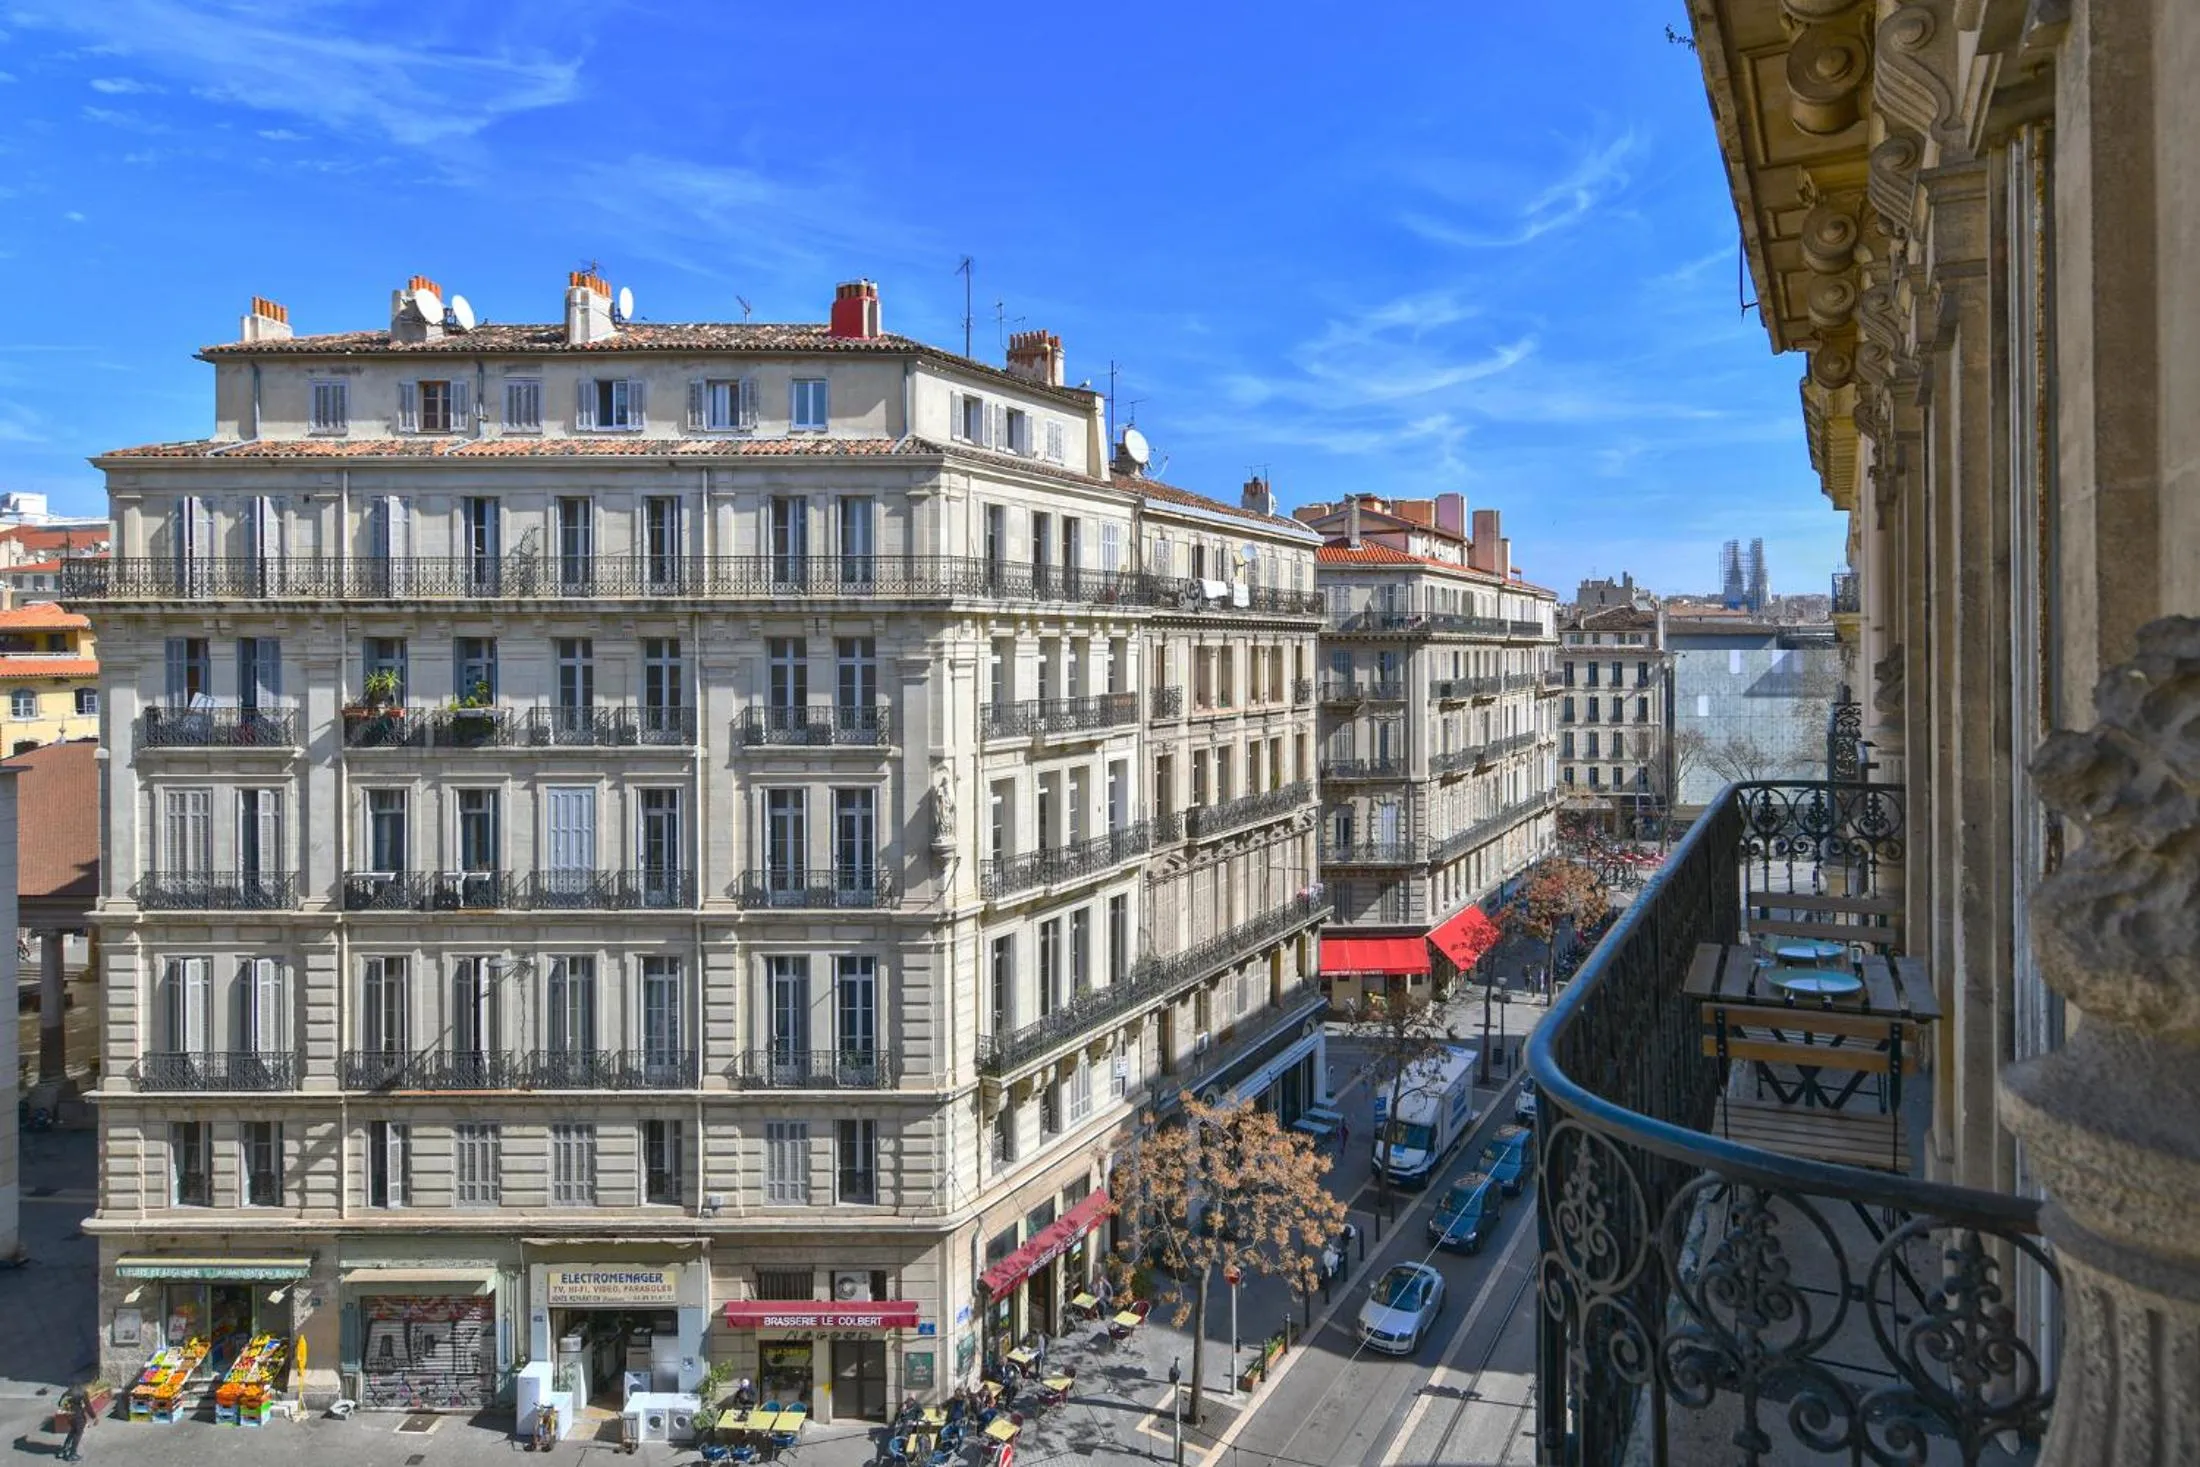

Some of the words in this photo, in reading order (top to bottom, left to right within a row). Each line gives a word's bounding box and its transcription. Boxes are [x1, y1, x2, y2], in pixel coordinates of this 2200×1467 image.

[561, 1272, 663, 1284] ELECTROMENAGER
[763, 1316, 818, 1327] BRASSERIE
[822, 1316, 834, 1326] LE
[838, 1316, 883, 1326] COLBERT
